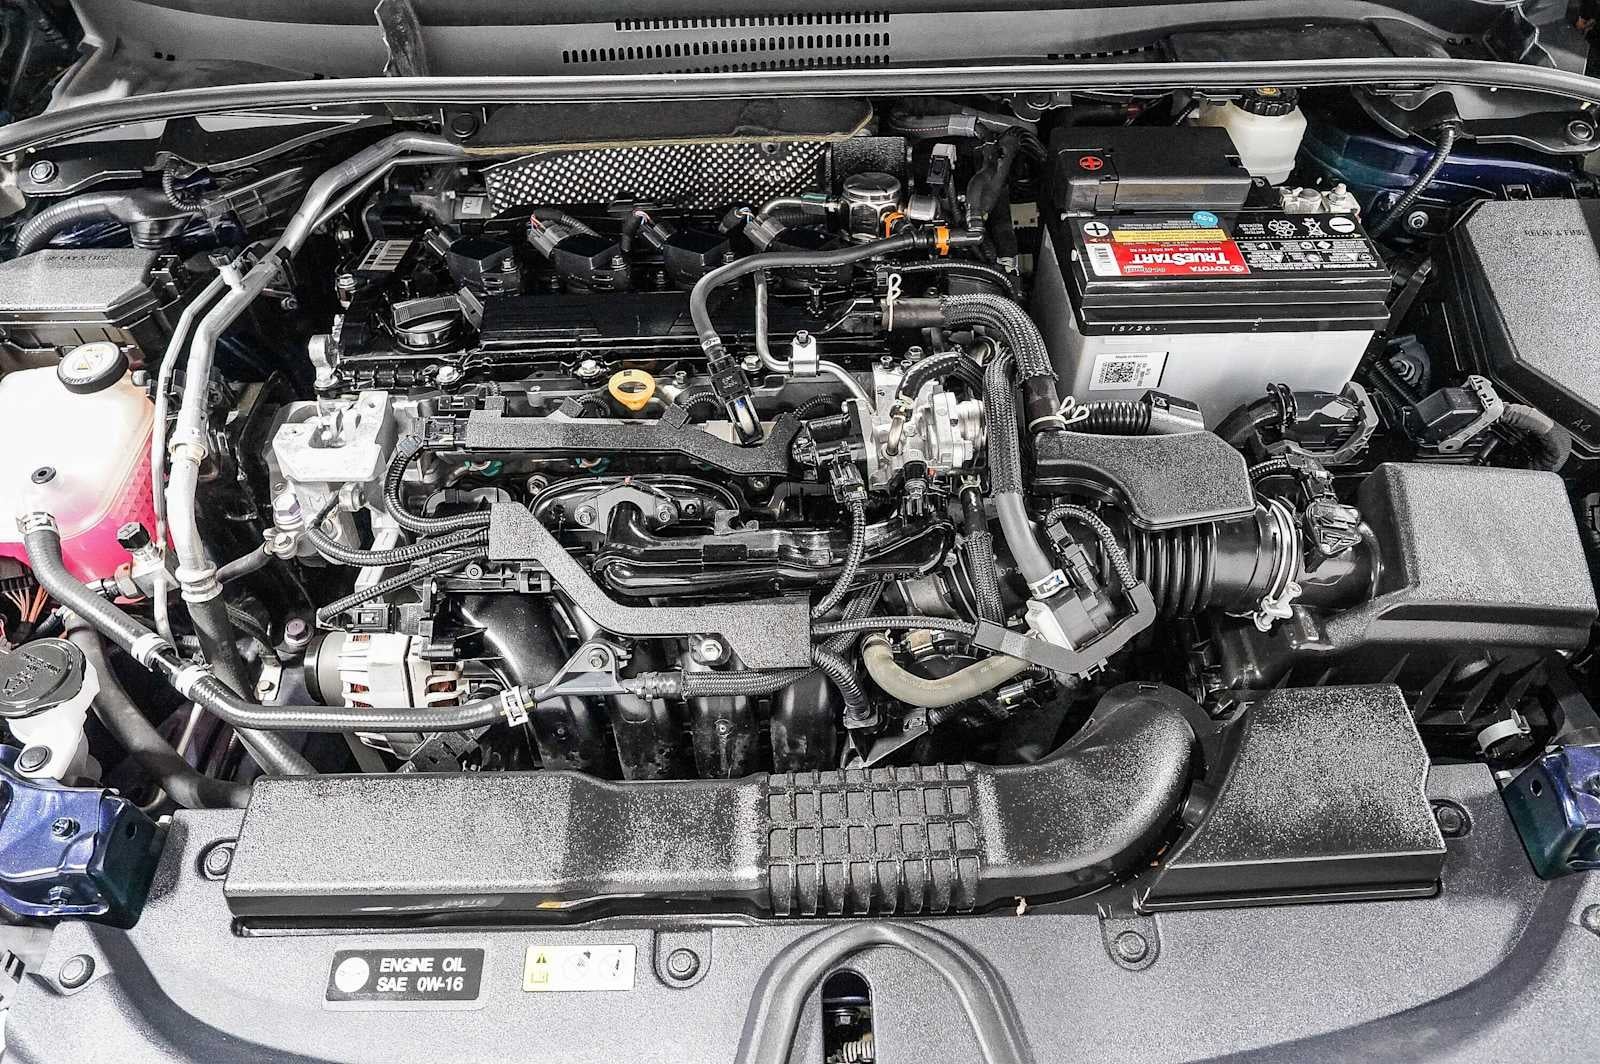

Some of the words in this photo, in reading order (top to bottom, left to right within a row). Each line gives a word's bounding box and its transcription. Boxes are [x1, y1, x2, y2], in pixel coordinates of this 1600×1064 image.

[1190, 265, 1229, 273] TOYOTA
[379, 957, 435, 973] ENGINE
[442, 957, 467, 972] OIL
[376, 976, 409, 992] SAE
[416, 976, 464, 992] 0W-16
